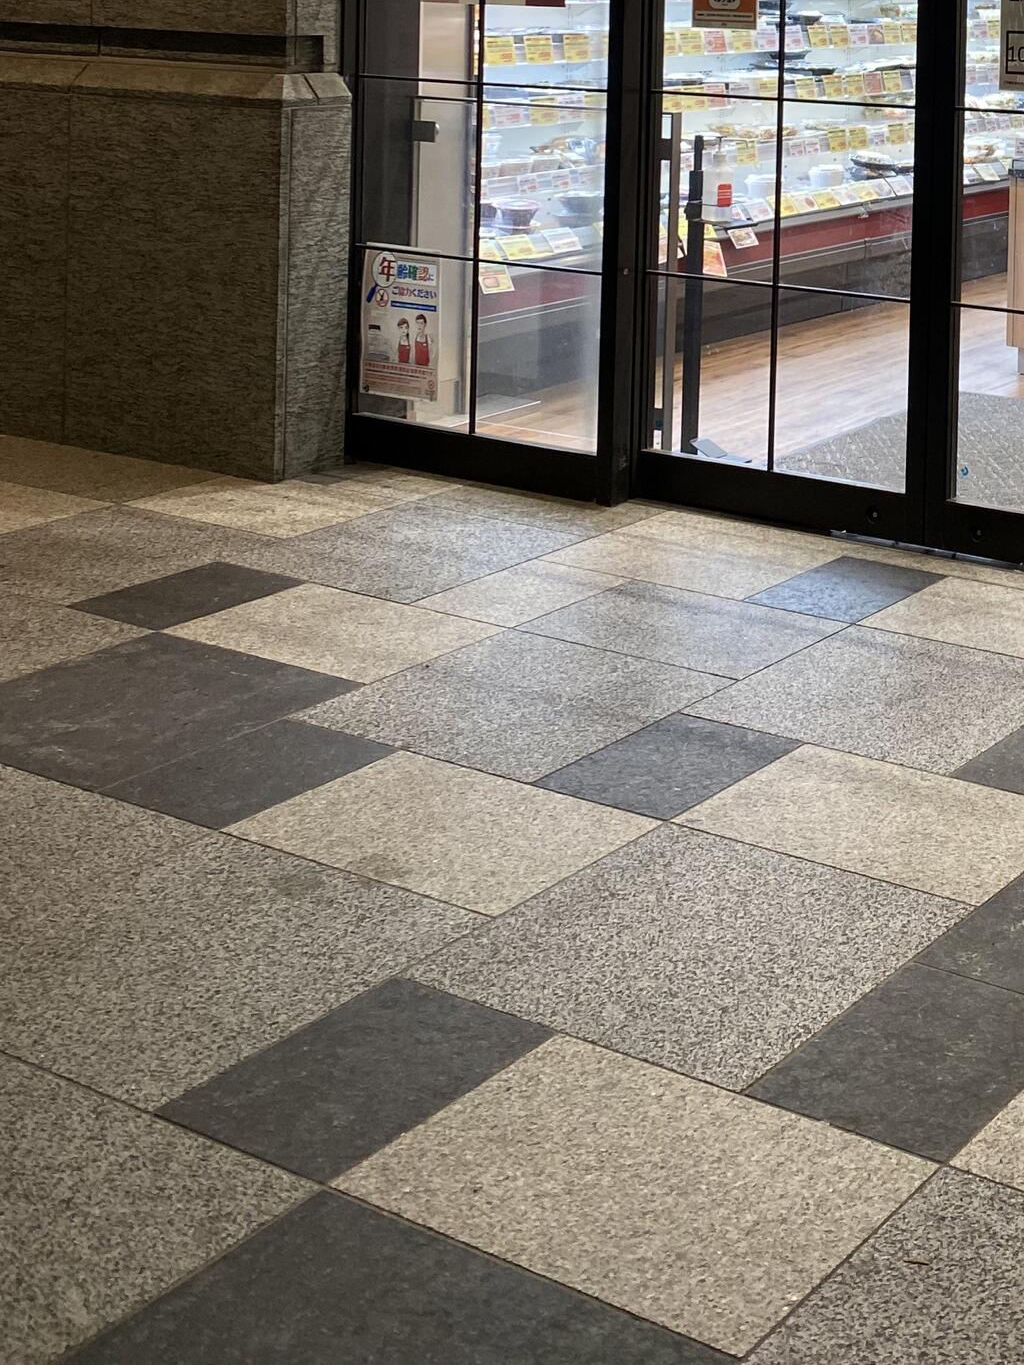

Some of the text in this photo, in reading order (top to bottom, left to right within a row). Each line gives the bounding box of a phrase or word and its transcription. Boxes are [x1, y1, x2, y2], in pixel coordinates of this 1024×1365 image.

[379, 256, 435, 282] 年齢確認に
[392, 286, 437, 299] ご協力ください
